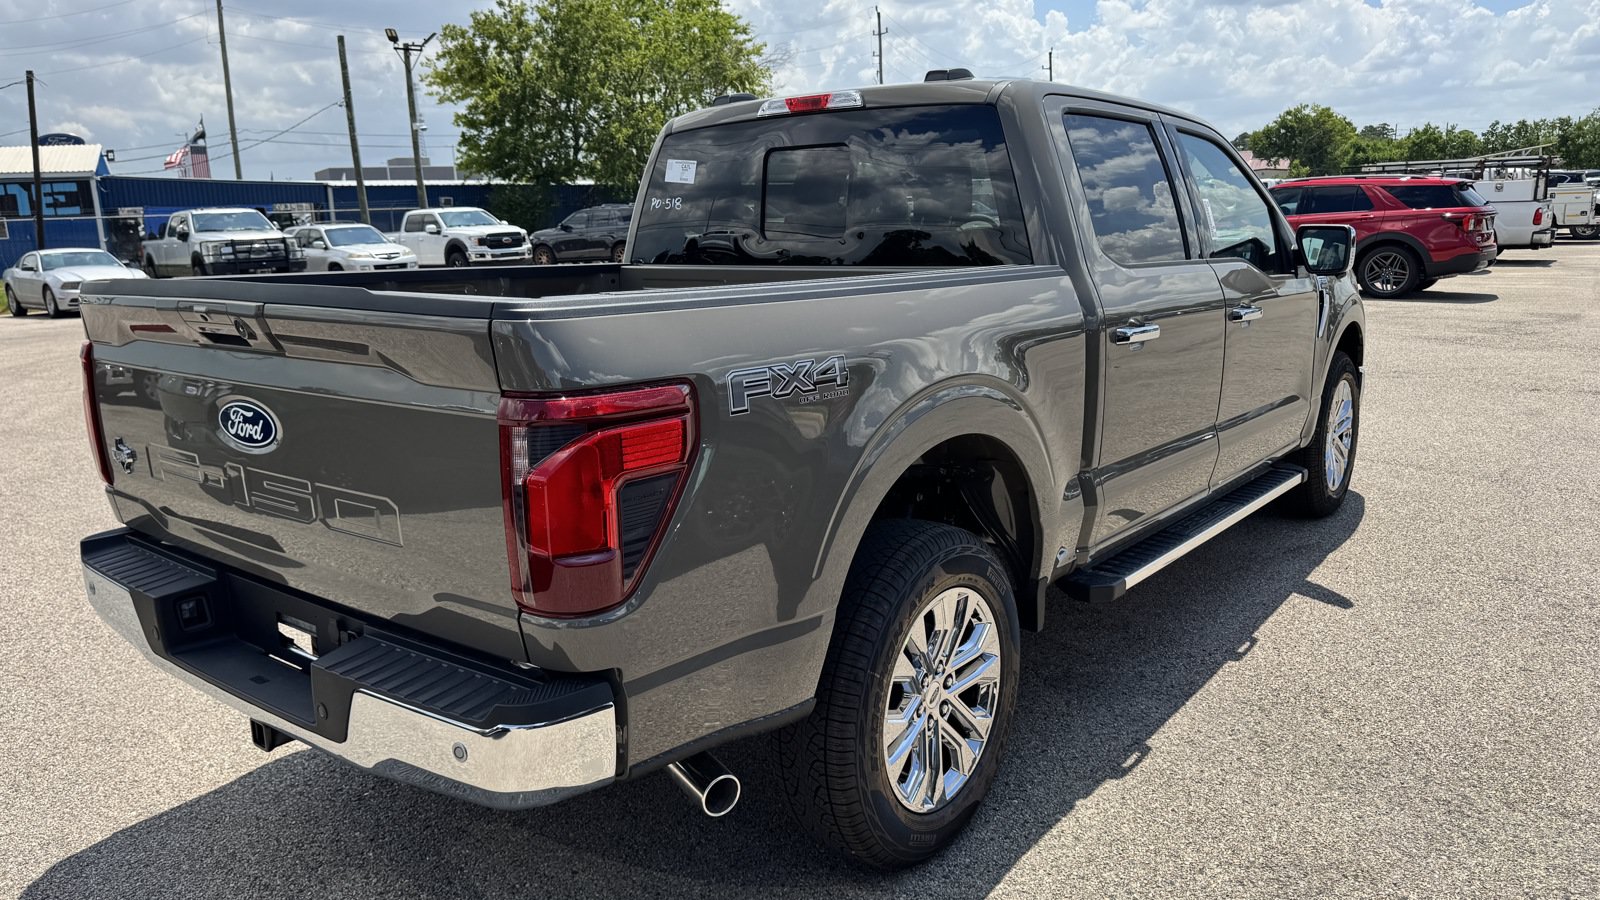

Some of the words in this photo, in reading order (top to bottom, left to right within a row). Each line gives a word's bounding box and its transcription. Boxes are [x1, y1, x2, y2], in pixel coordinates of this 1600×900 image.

[726, 354, 849, 416] FX4
[799, 393, 820, 405] OFF
[823, 388, 849, 401] ROAD
[227, 407, 264, 441] Ford
[146, 443, 404, 548] F-150
